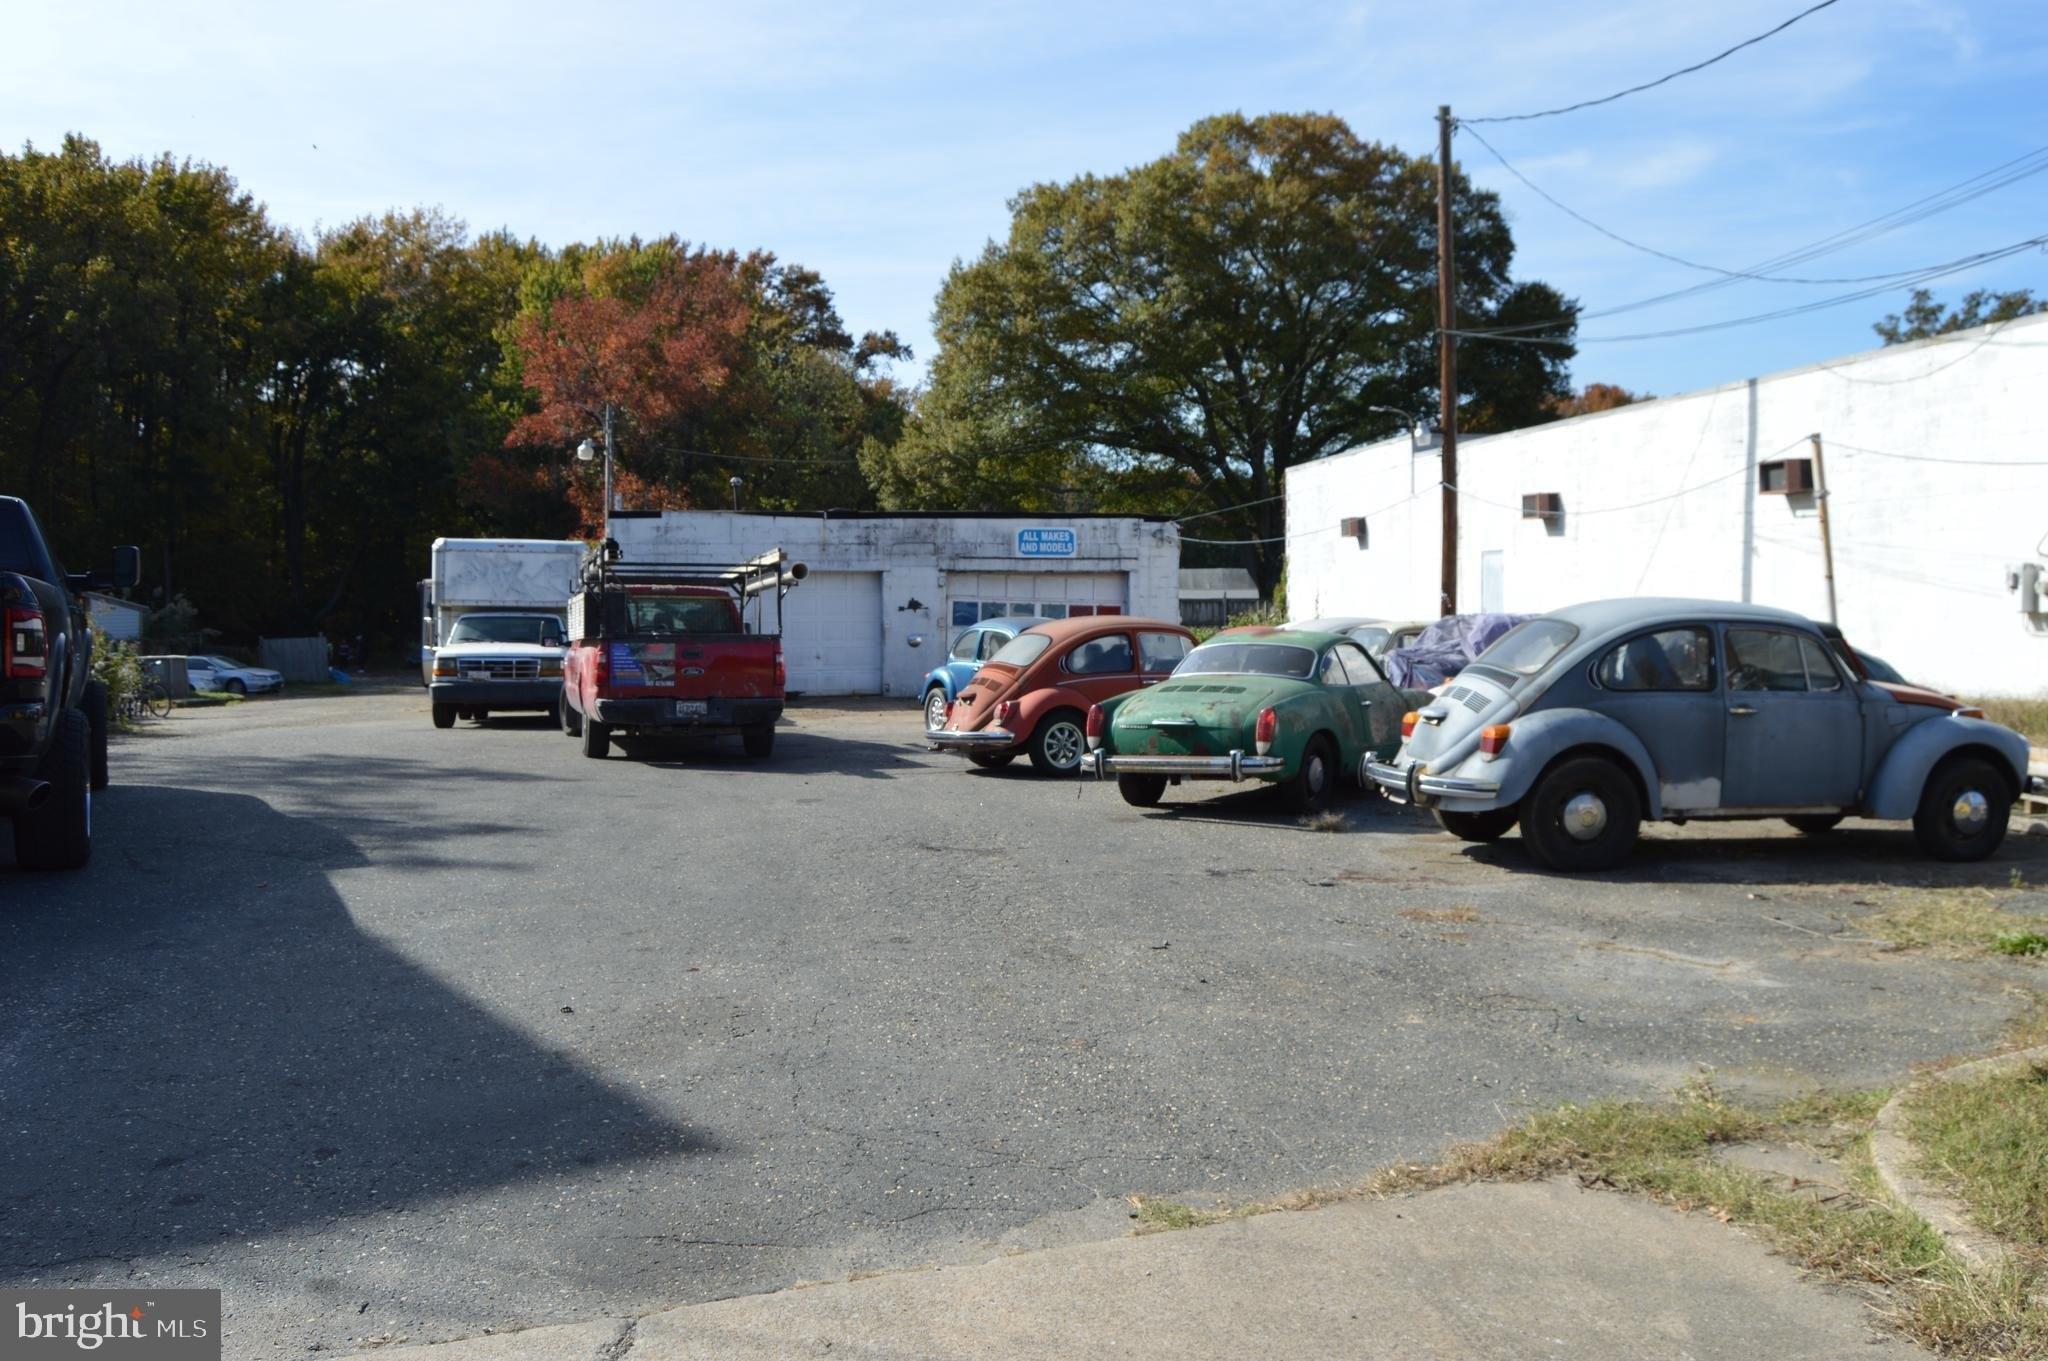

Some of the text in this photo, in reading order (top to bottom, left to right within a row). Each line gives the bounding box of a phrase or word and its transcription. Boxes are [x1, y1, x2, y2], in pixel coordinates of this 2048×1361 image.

[1023, 531, 1070, 541] ALL MAKES
[1020, 542, 1073, 552] AND MODELS
